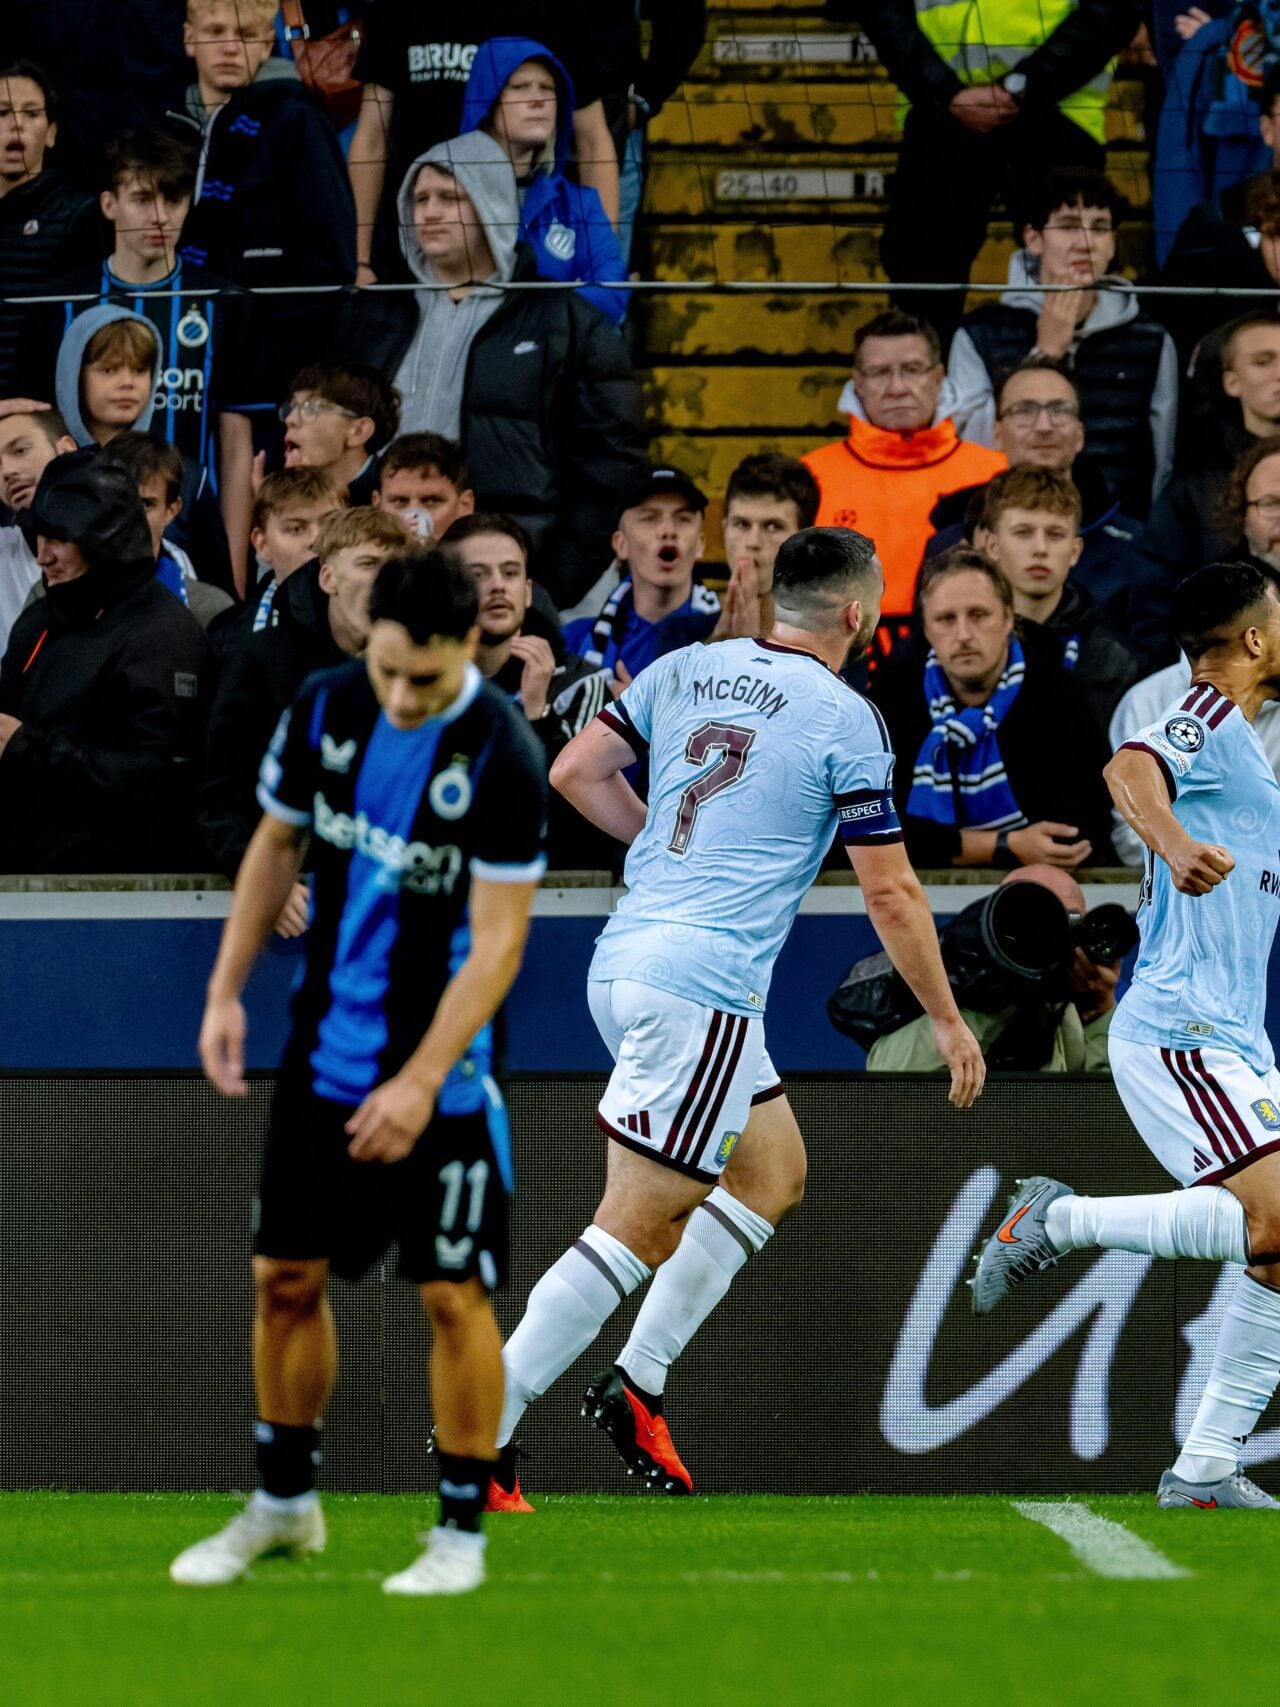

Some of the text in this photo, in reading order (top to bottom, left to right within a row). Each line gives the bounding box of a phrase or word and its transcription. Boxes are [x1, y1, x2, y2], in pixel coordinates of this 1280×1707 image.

[408, 42, 479, 72] BRUG
[693, 674, 789, 720] McGINN
[665, 720, 759, 857] 7
[841, 802, 882, 820] RESPECT
[438, 1159, 489, 1233] 11
